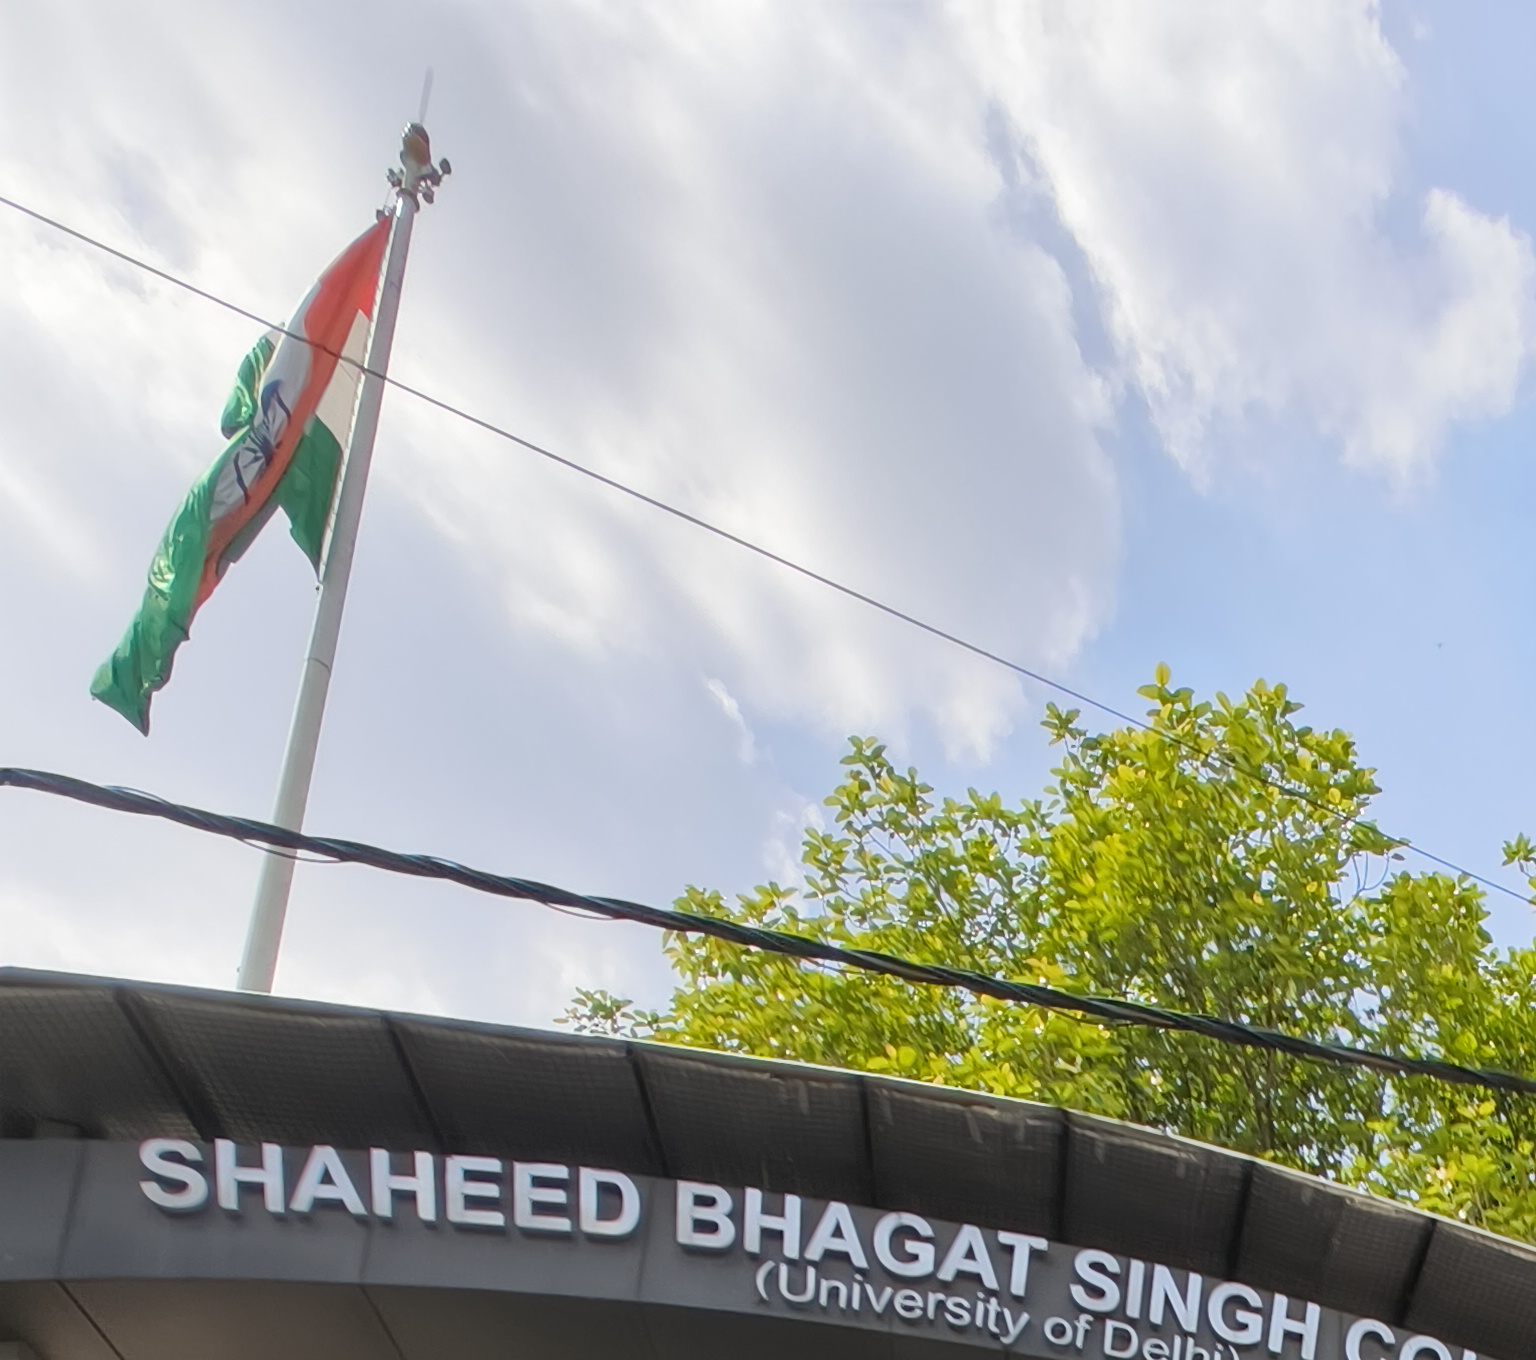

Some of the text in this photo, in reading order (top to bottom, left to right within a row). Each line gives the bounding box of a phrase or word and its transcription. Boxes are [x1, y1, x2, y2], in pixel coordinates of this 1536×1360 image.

[138, 1138, 641, 1237] SHAHEED
[675, 1180, 1048, 1297] BHAGAT
[755, 1260, 1030, 1345] (University
[1044, 1313, 1092, 1349] of
